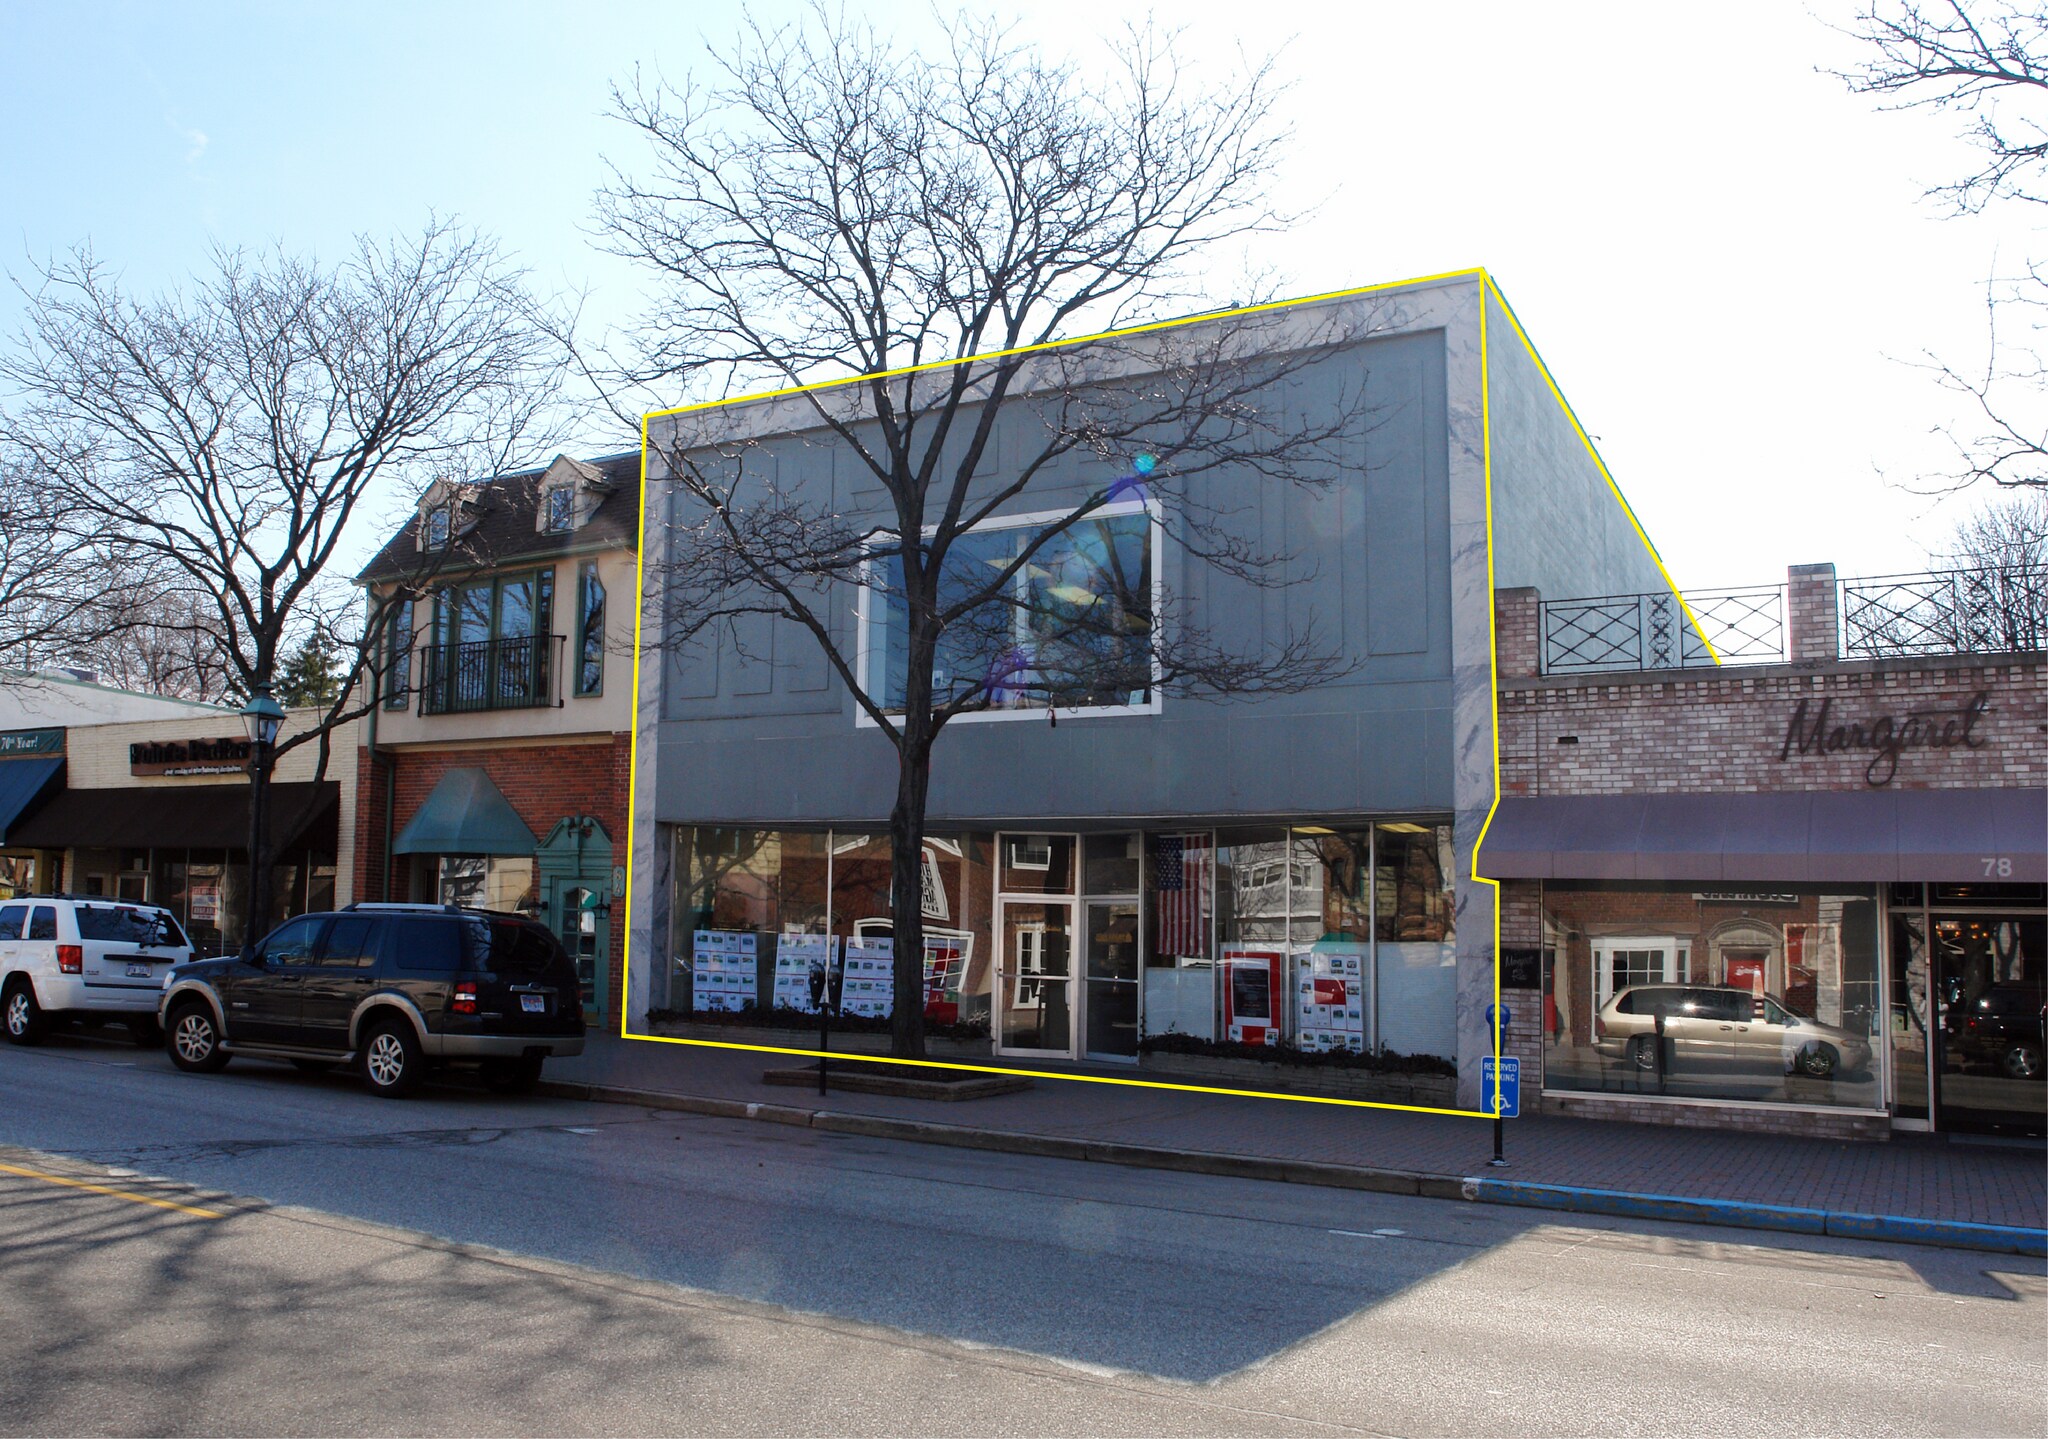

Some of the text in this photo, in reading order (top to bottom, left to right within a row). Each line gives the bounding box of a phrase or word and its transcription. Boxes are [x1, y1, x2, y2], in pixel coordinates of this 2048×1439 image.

[17, 735, 38, 749] Year!
[1780, 691, 1998, 786] Margaret
[1981, 857, 2012, 877] 78
[1483, 1062, 1518, 1072] RESRVED
[1485, 1072, 1516, 1082] PAKING
